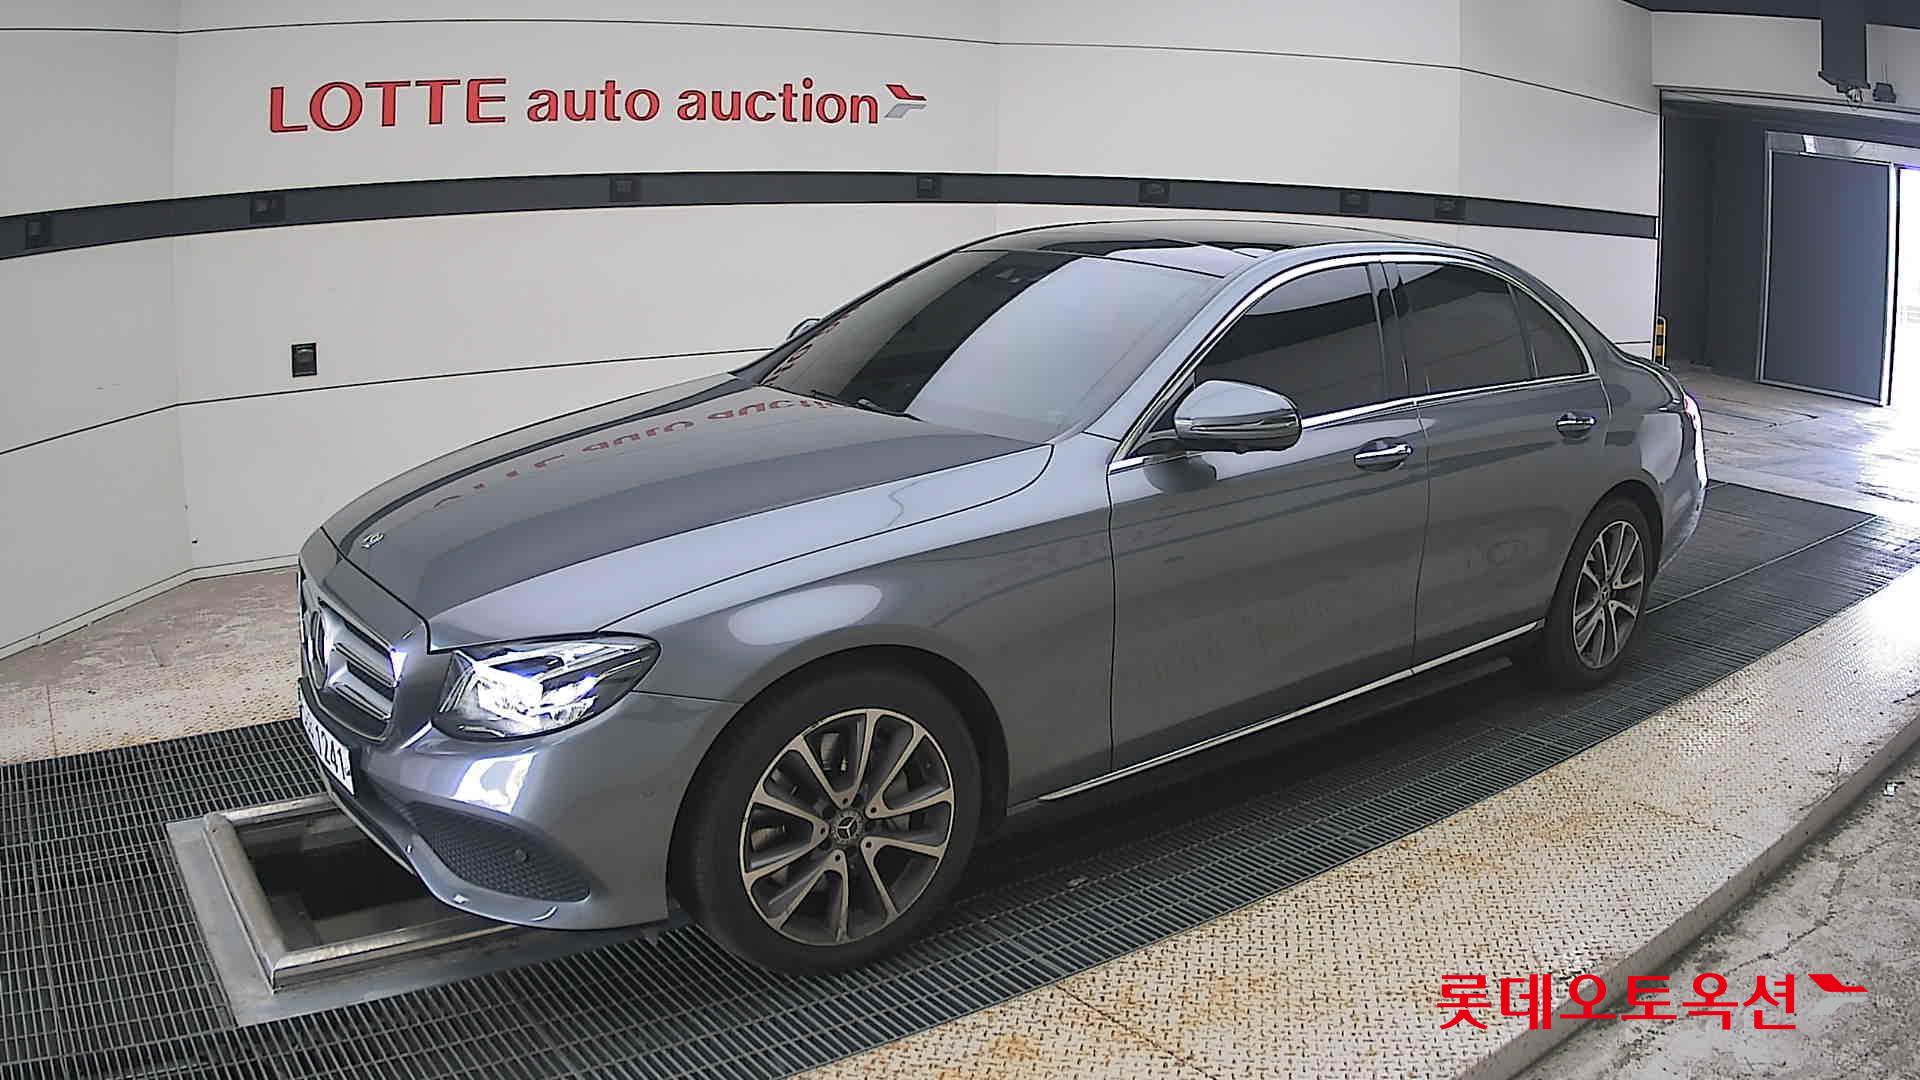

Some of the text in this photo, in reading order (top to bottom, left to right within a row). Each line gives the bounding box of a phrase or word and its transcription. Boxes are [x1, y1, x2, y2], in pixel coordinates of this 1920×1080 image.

[269, 78, 880, 133] LOTTE auto auction
